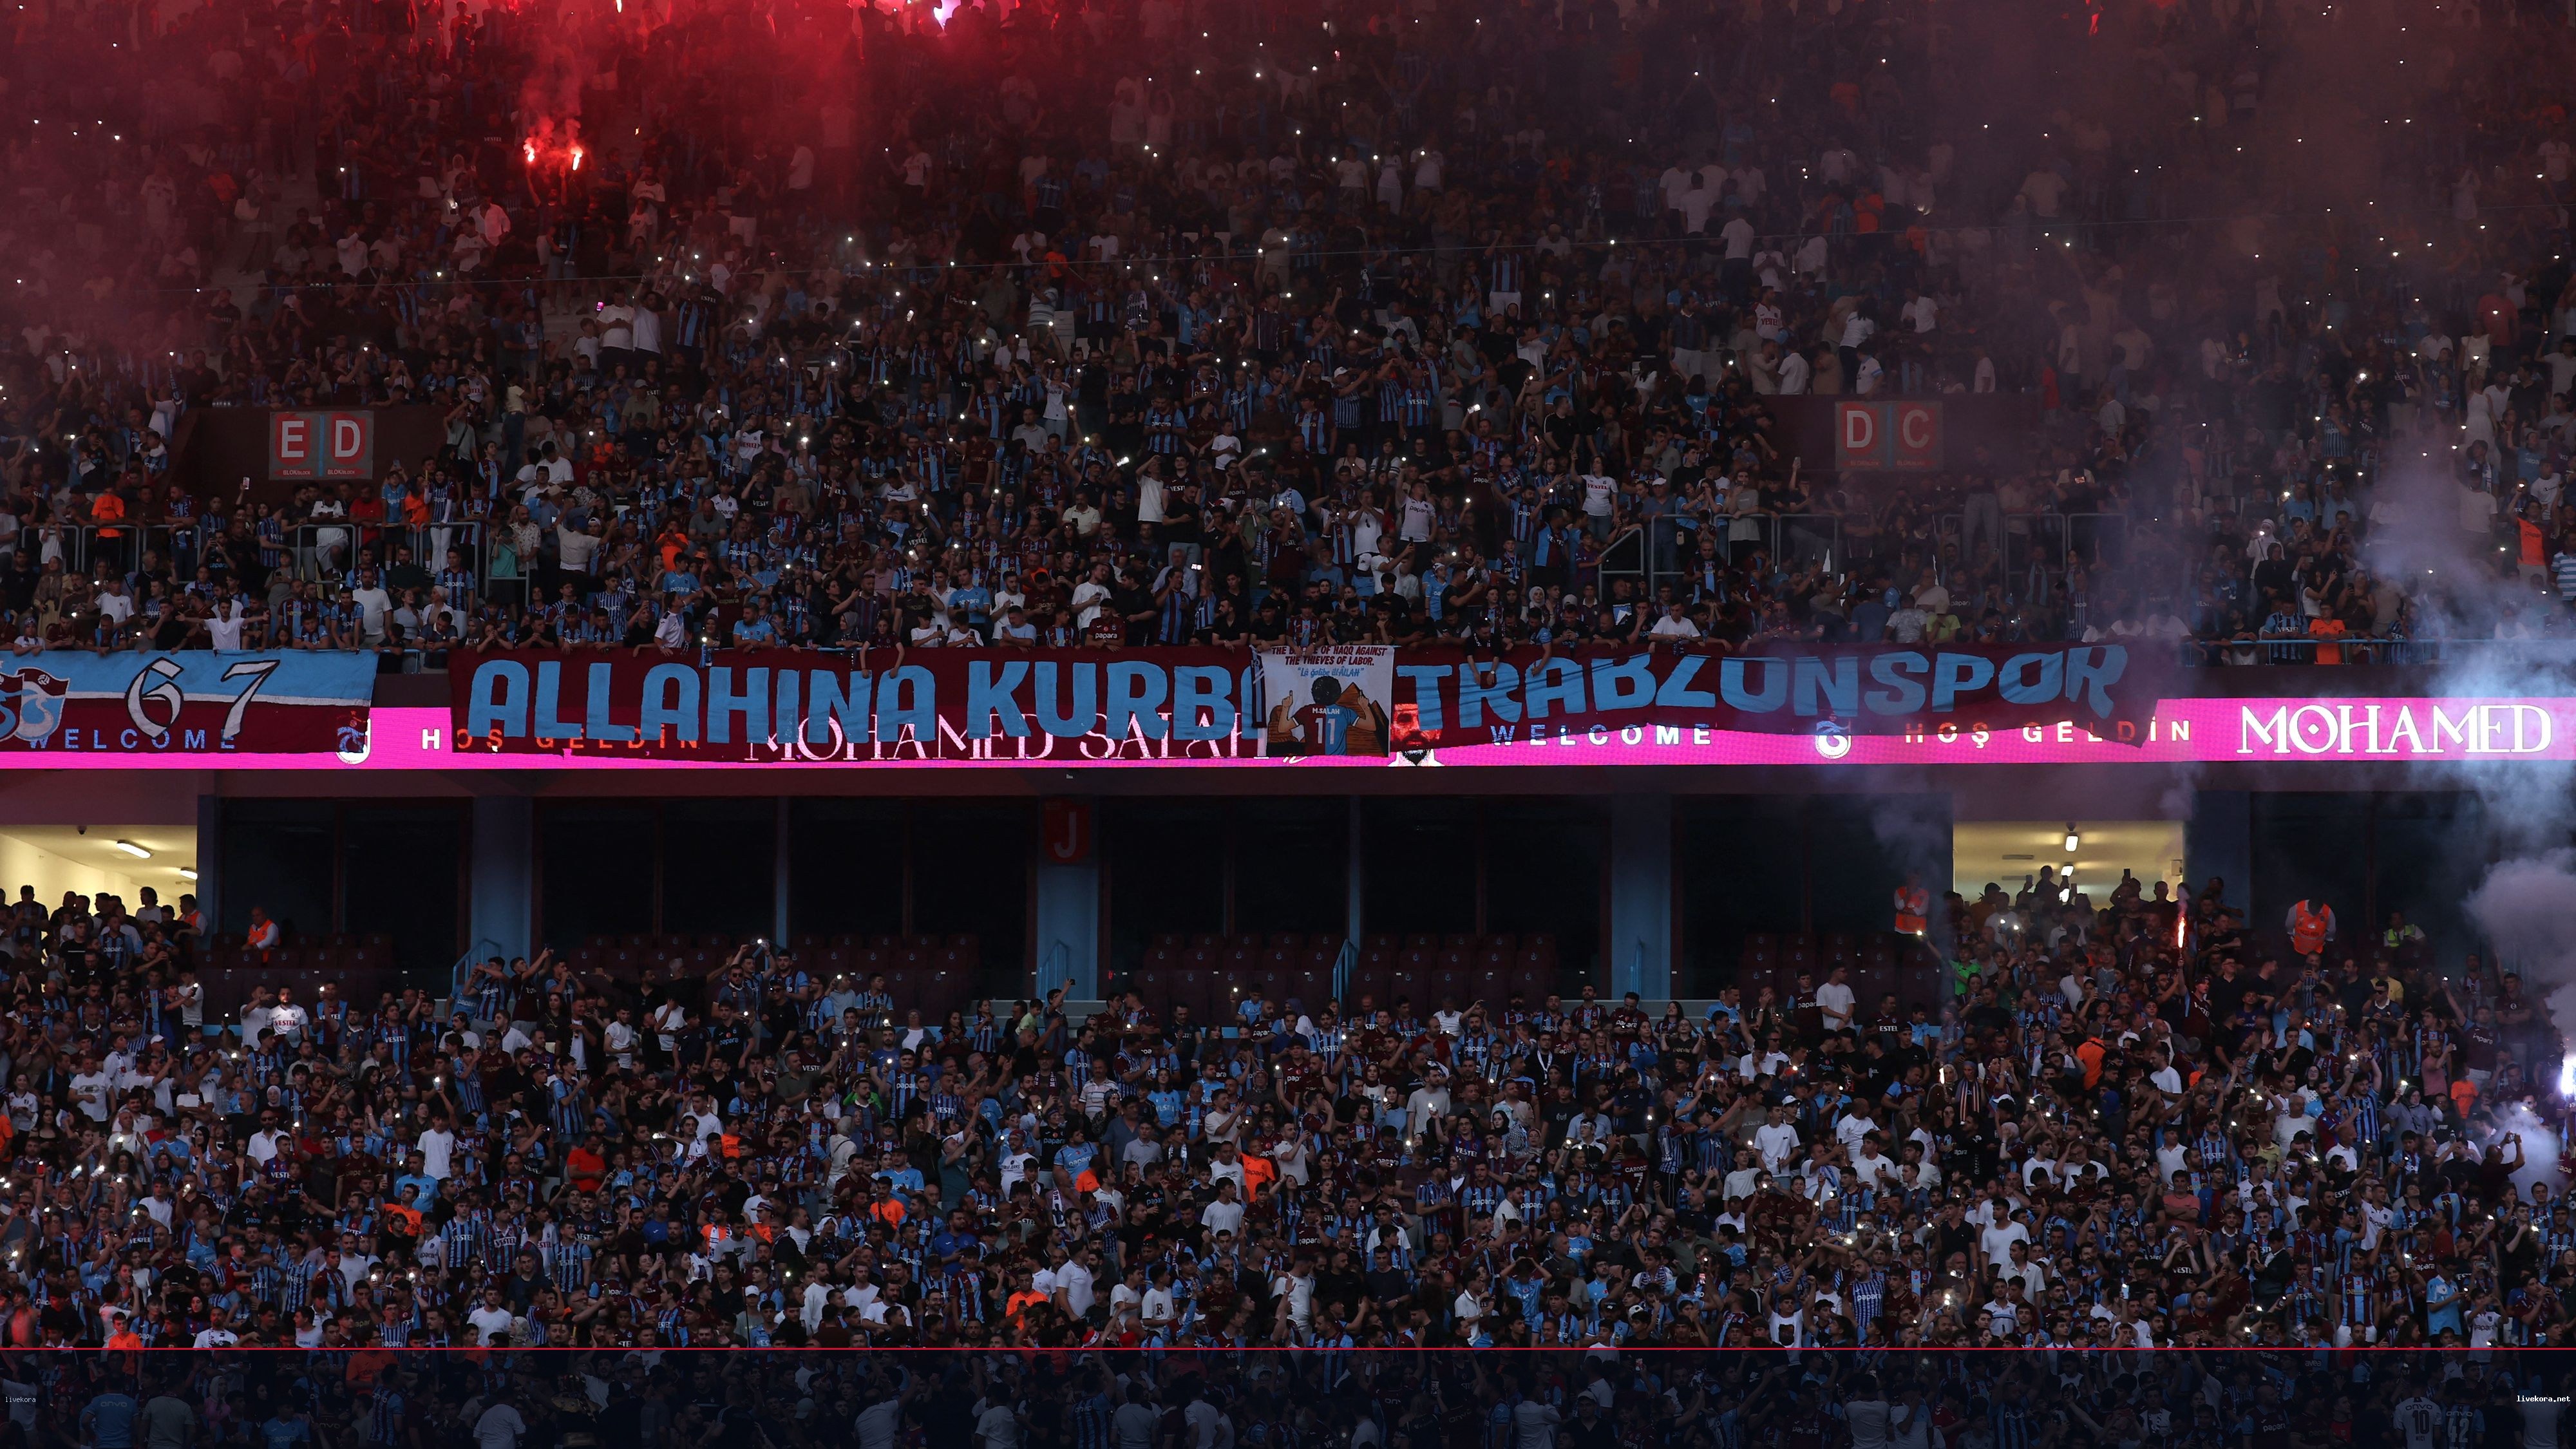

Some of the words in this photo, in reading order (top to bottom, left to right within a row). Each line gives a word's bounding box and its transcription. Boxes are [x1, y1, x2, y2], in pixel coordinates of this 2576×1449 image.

[281, 421, 305, 458] E
[335, 420, 361, 457] D
[1846, 410, 1873, 448] D
[1903, 410, 1929, 449] C
[1409, 505, 1429, 514] papara
[1285, 656, 1300, 665] THE
[1303, 656, 1334, 665] THIEVES
[1336, 656, 1347, 665] OF
[1349, 656, 1374, 666] LABOR.
[1333, 646, 1354, 655] HAQQ
[1356, 647, 1388, 656] AGAINST
[1396, 645, 2127, 730] TRABZONSPOR
[468, 660, 936, 744] ALLAHINA
[1315, 717, 1336, 744] 11
[1490, 725, 1712, 746] WELCOME
[1905, 722, 1990, 748] HOŞ
[2022, 715, 2190, 743] GELDİN
[2237, 705, 2552, 753] MOHAMED
[1054, 811, 1076, 858] J
[1068, 1156, 1092, 1167] papara
[1455, 1146, 1477, 1157] VESTEL
[1634, 1173, 1643, 1192] 7
[495, 1238, 516, 1246] VESTEL
[1157, 1303, 1164, 1314] R
[1857, 1293, 1881, 1302] papara
[2412, 1410, 2429, 1434] 10
[2448, 1418, 2470, 1443] 42
